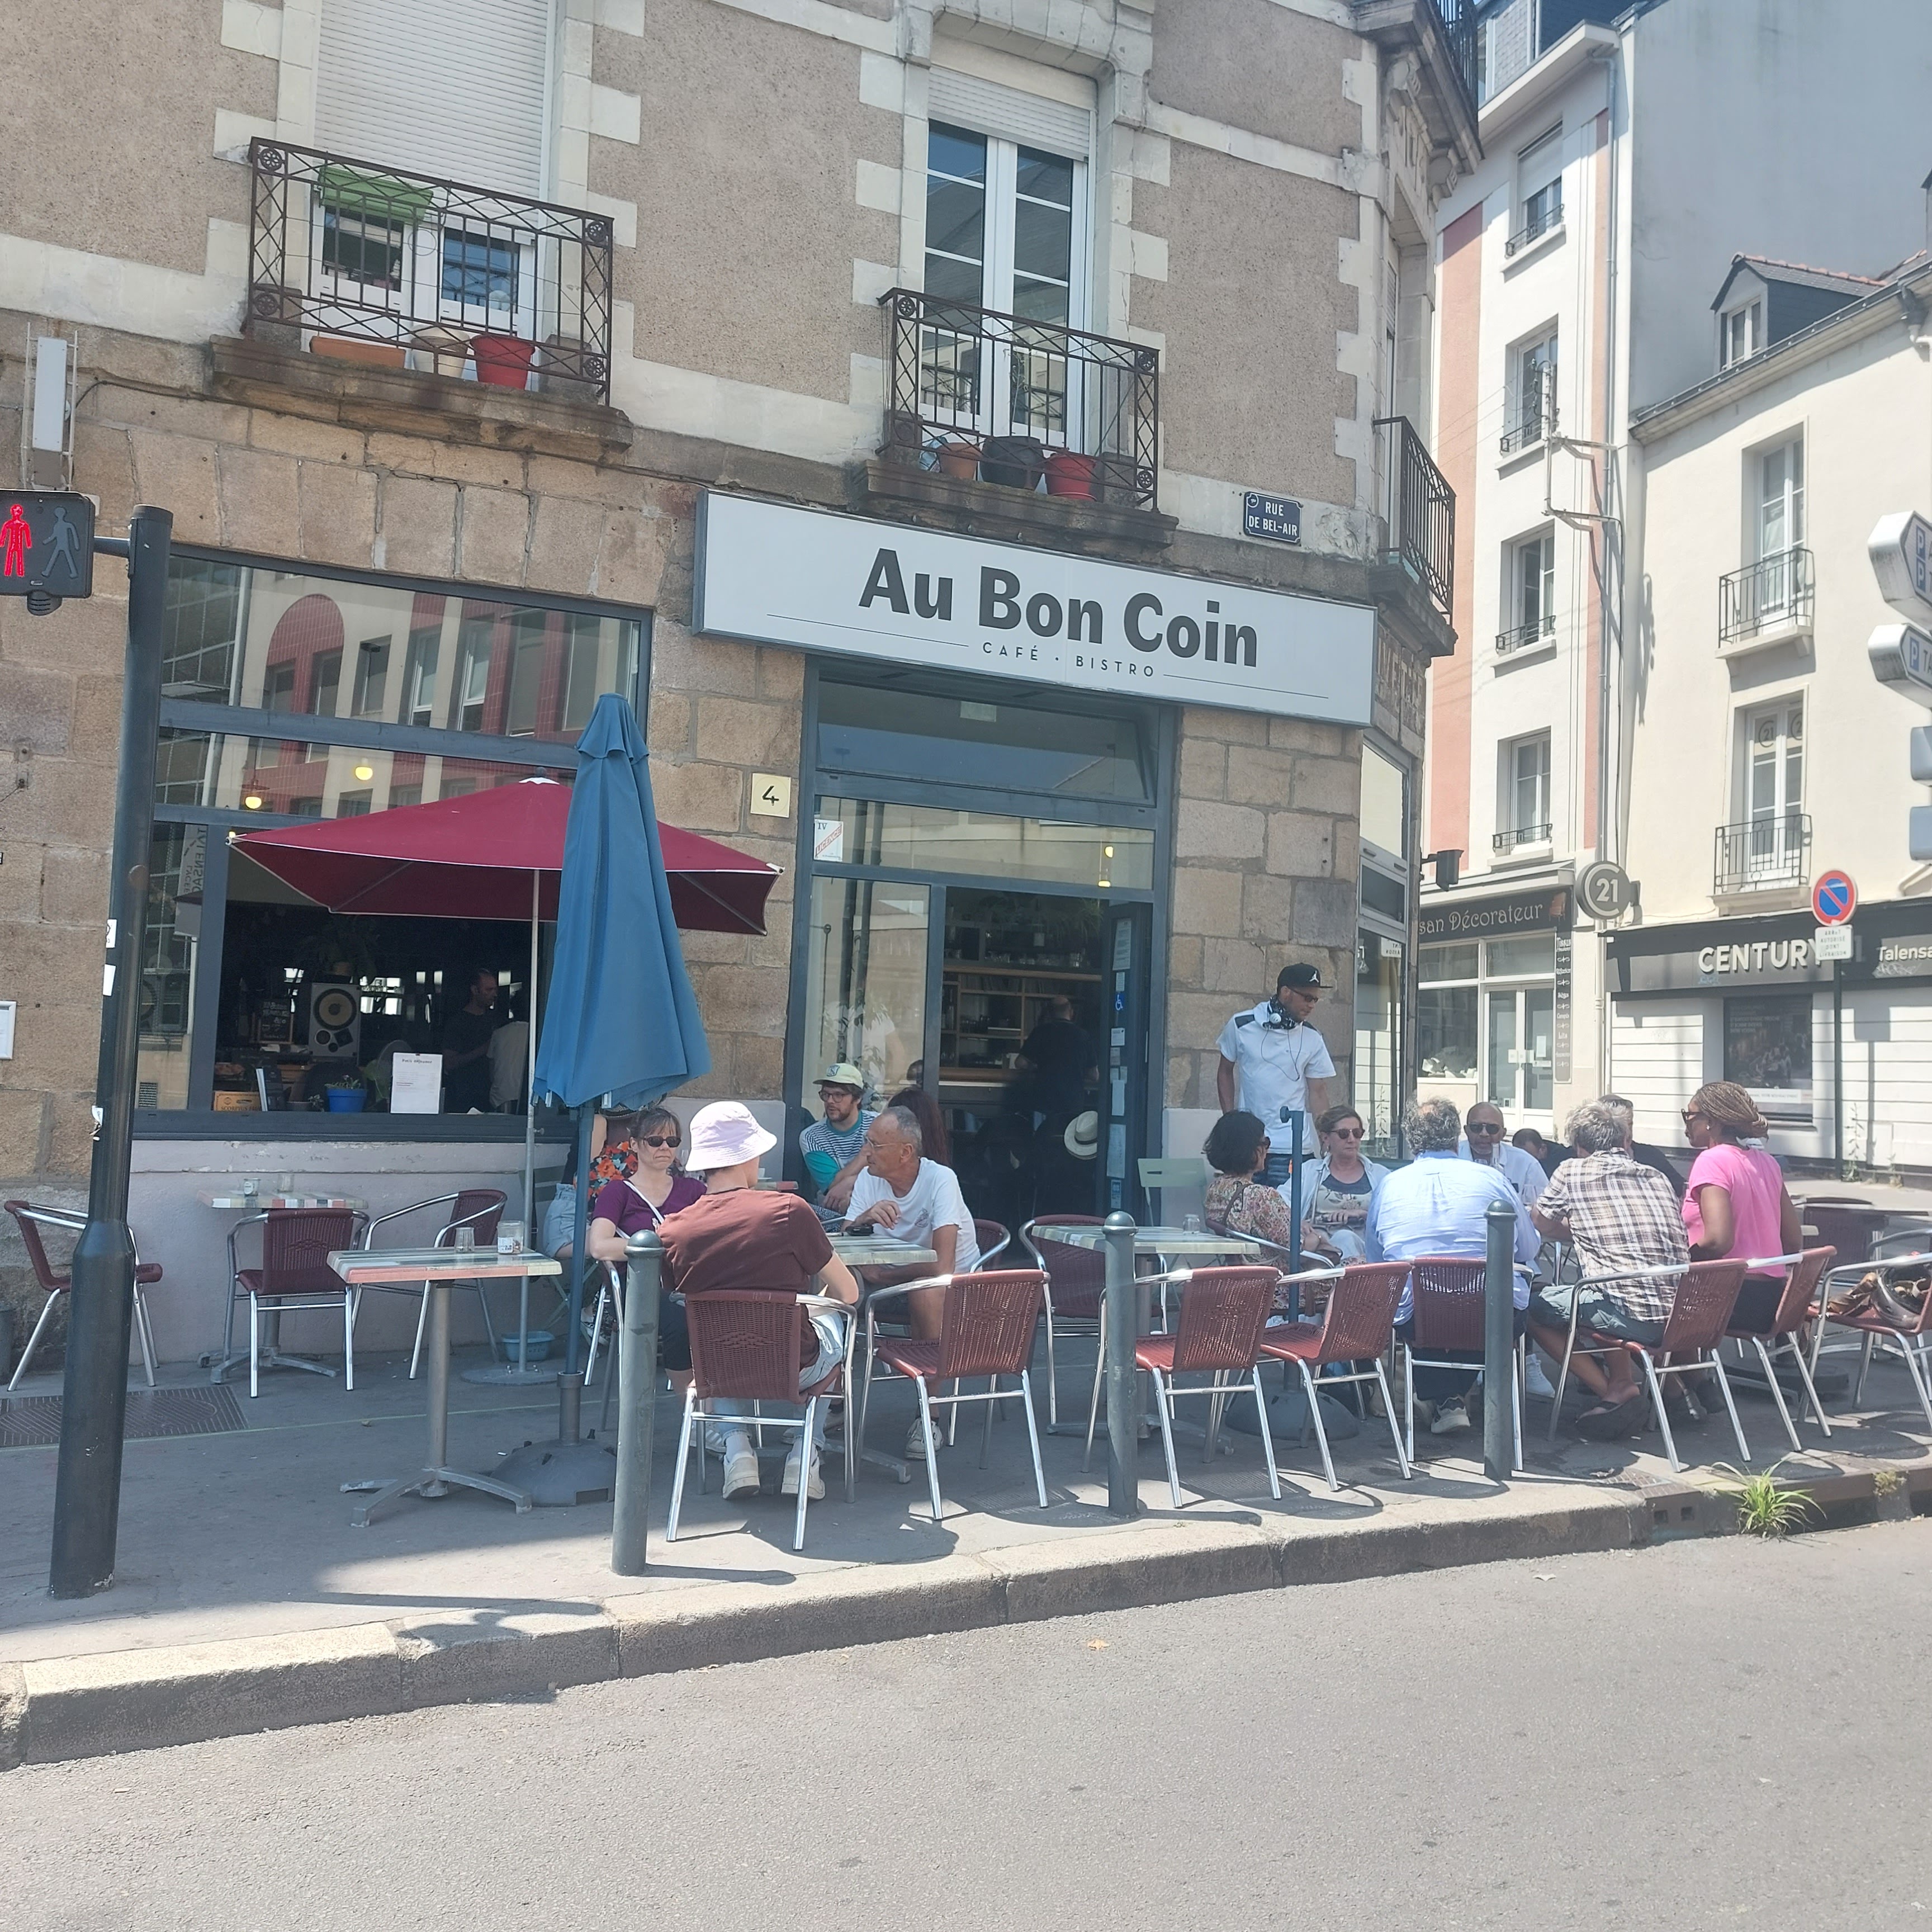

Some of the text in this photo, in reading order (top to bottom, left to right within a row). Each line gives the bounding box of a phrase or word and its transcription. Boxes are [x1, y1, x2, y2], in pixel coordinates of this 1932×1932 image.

[1265, 501, 1284, 516] RUE
[1248, 515, 1298, 537] DE BEL-AIR
[858, 548, 1257, 668] Au Bon Coin
[983, 642, 1154, 677] CAFÉ BISTRO
[762, 785, 779, 806] 4
[816, 826, 842, 855] LICENCE
[1596, 878, 1618, 903] 21
[1448, 904, 1543, 931] Décorateur
